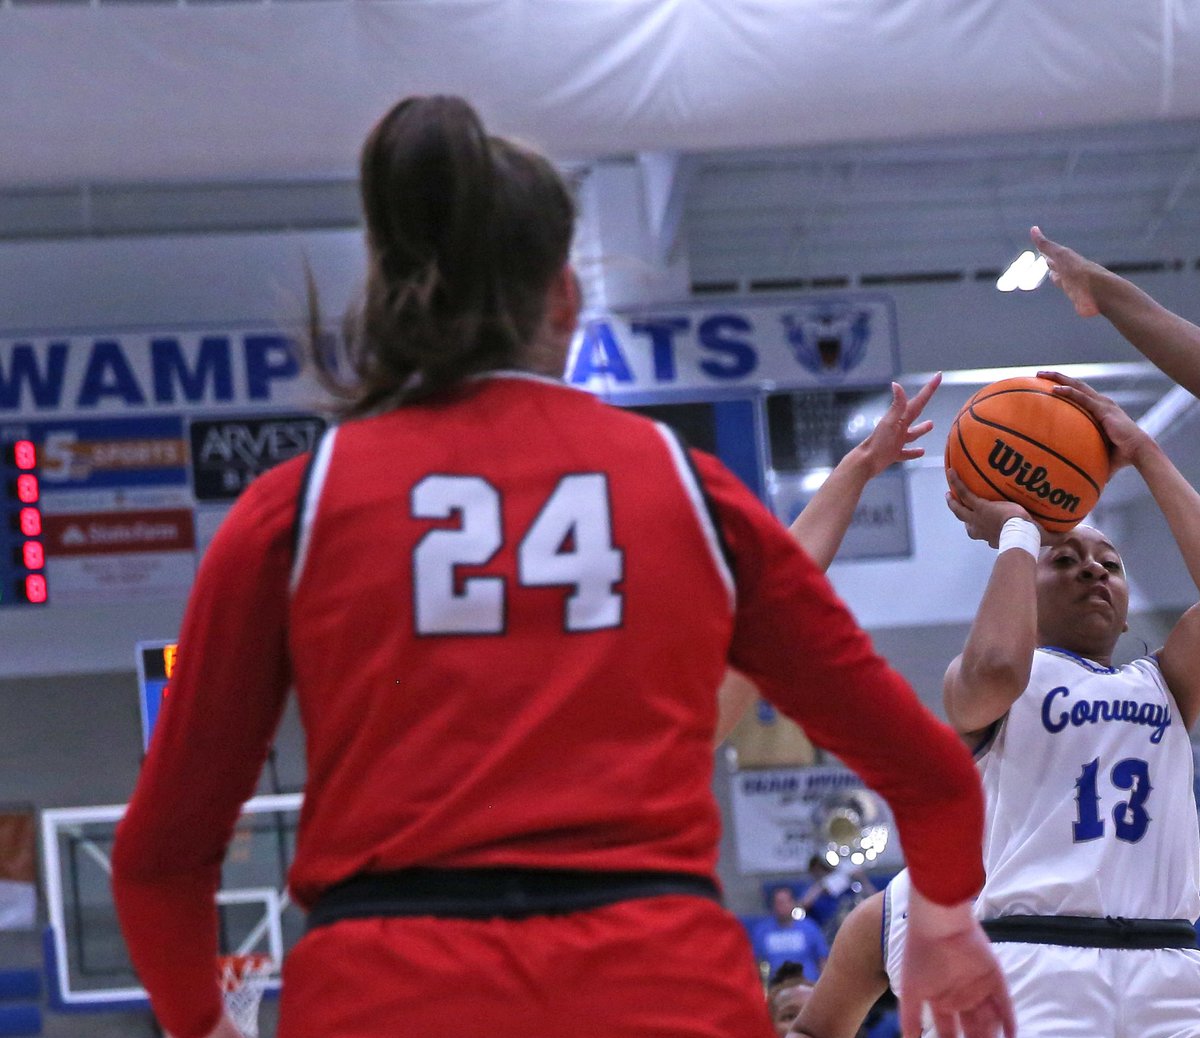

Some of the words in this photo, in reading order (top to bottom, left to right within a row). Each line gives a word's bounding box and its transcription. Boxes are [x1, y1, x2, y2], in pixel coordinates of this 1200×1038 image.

[0, 334, 340, 410] WAMP
[570, 314, 759, 384] ATS
[42, 431, 78, 481] 5
[987, 438, 1081, 514] Wilson
[409, 471, 625, 639] 24
[1041, 685, 1172, 744] Conway
[1072, 756, 1153, 845] 13
